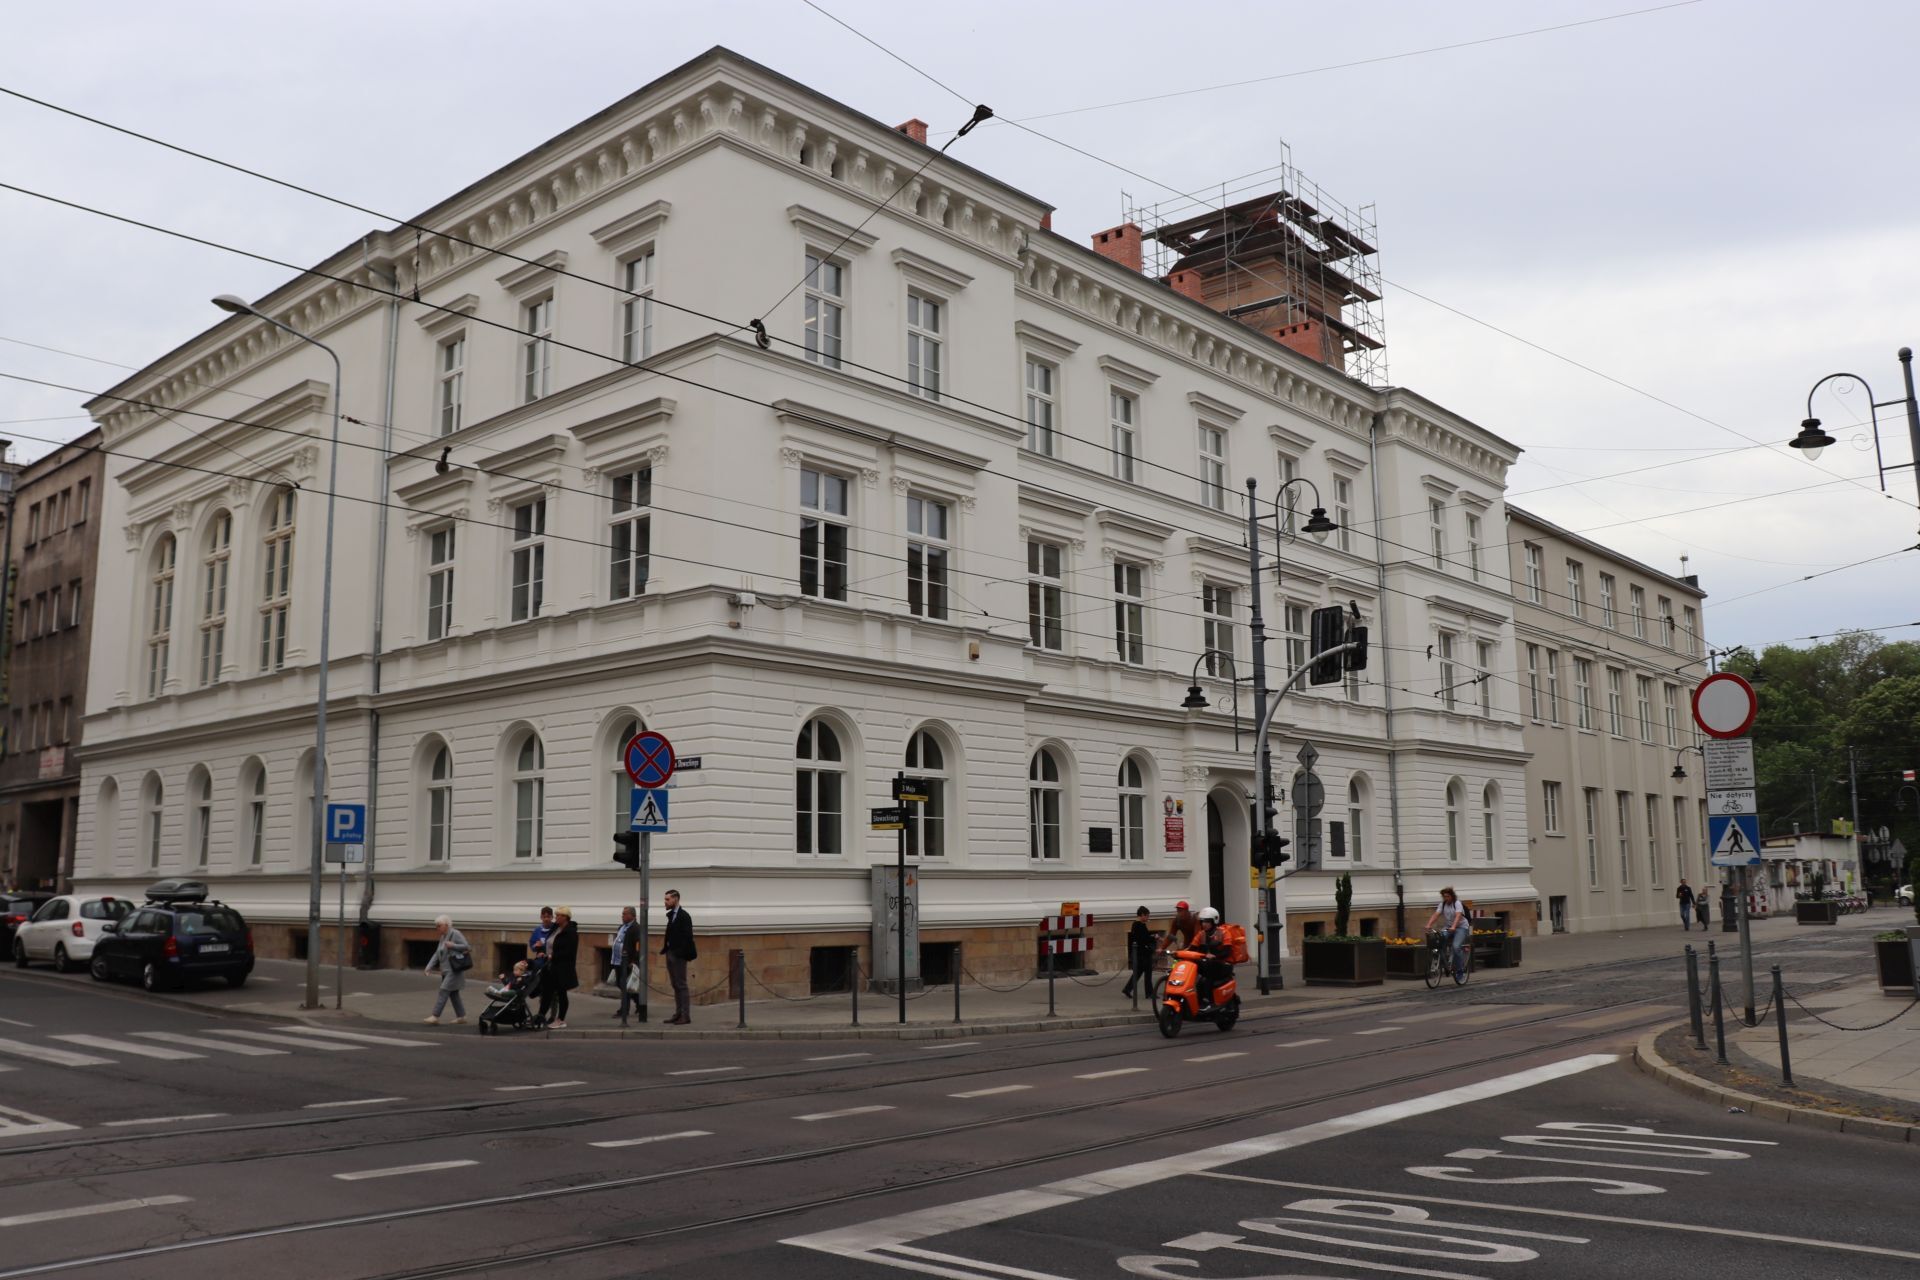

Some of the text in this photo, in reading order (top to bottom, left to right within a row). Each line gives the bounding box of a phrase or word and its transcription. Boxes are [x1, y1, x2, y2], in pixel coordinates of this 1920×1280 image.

[906, 785, 916, 793] Maja
[1726, 791, 1753, 799] dotyczy
[333, 808, 356, 838] P
[873, 815, 899, 823] Słowackiego
[1404, 1122, 1780, 1195] STOP
